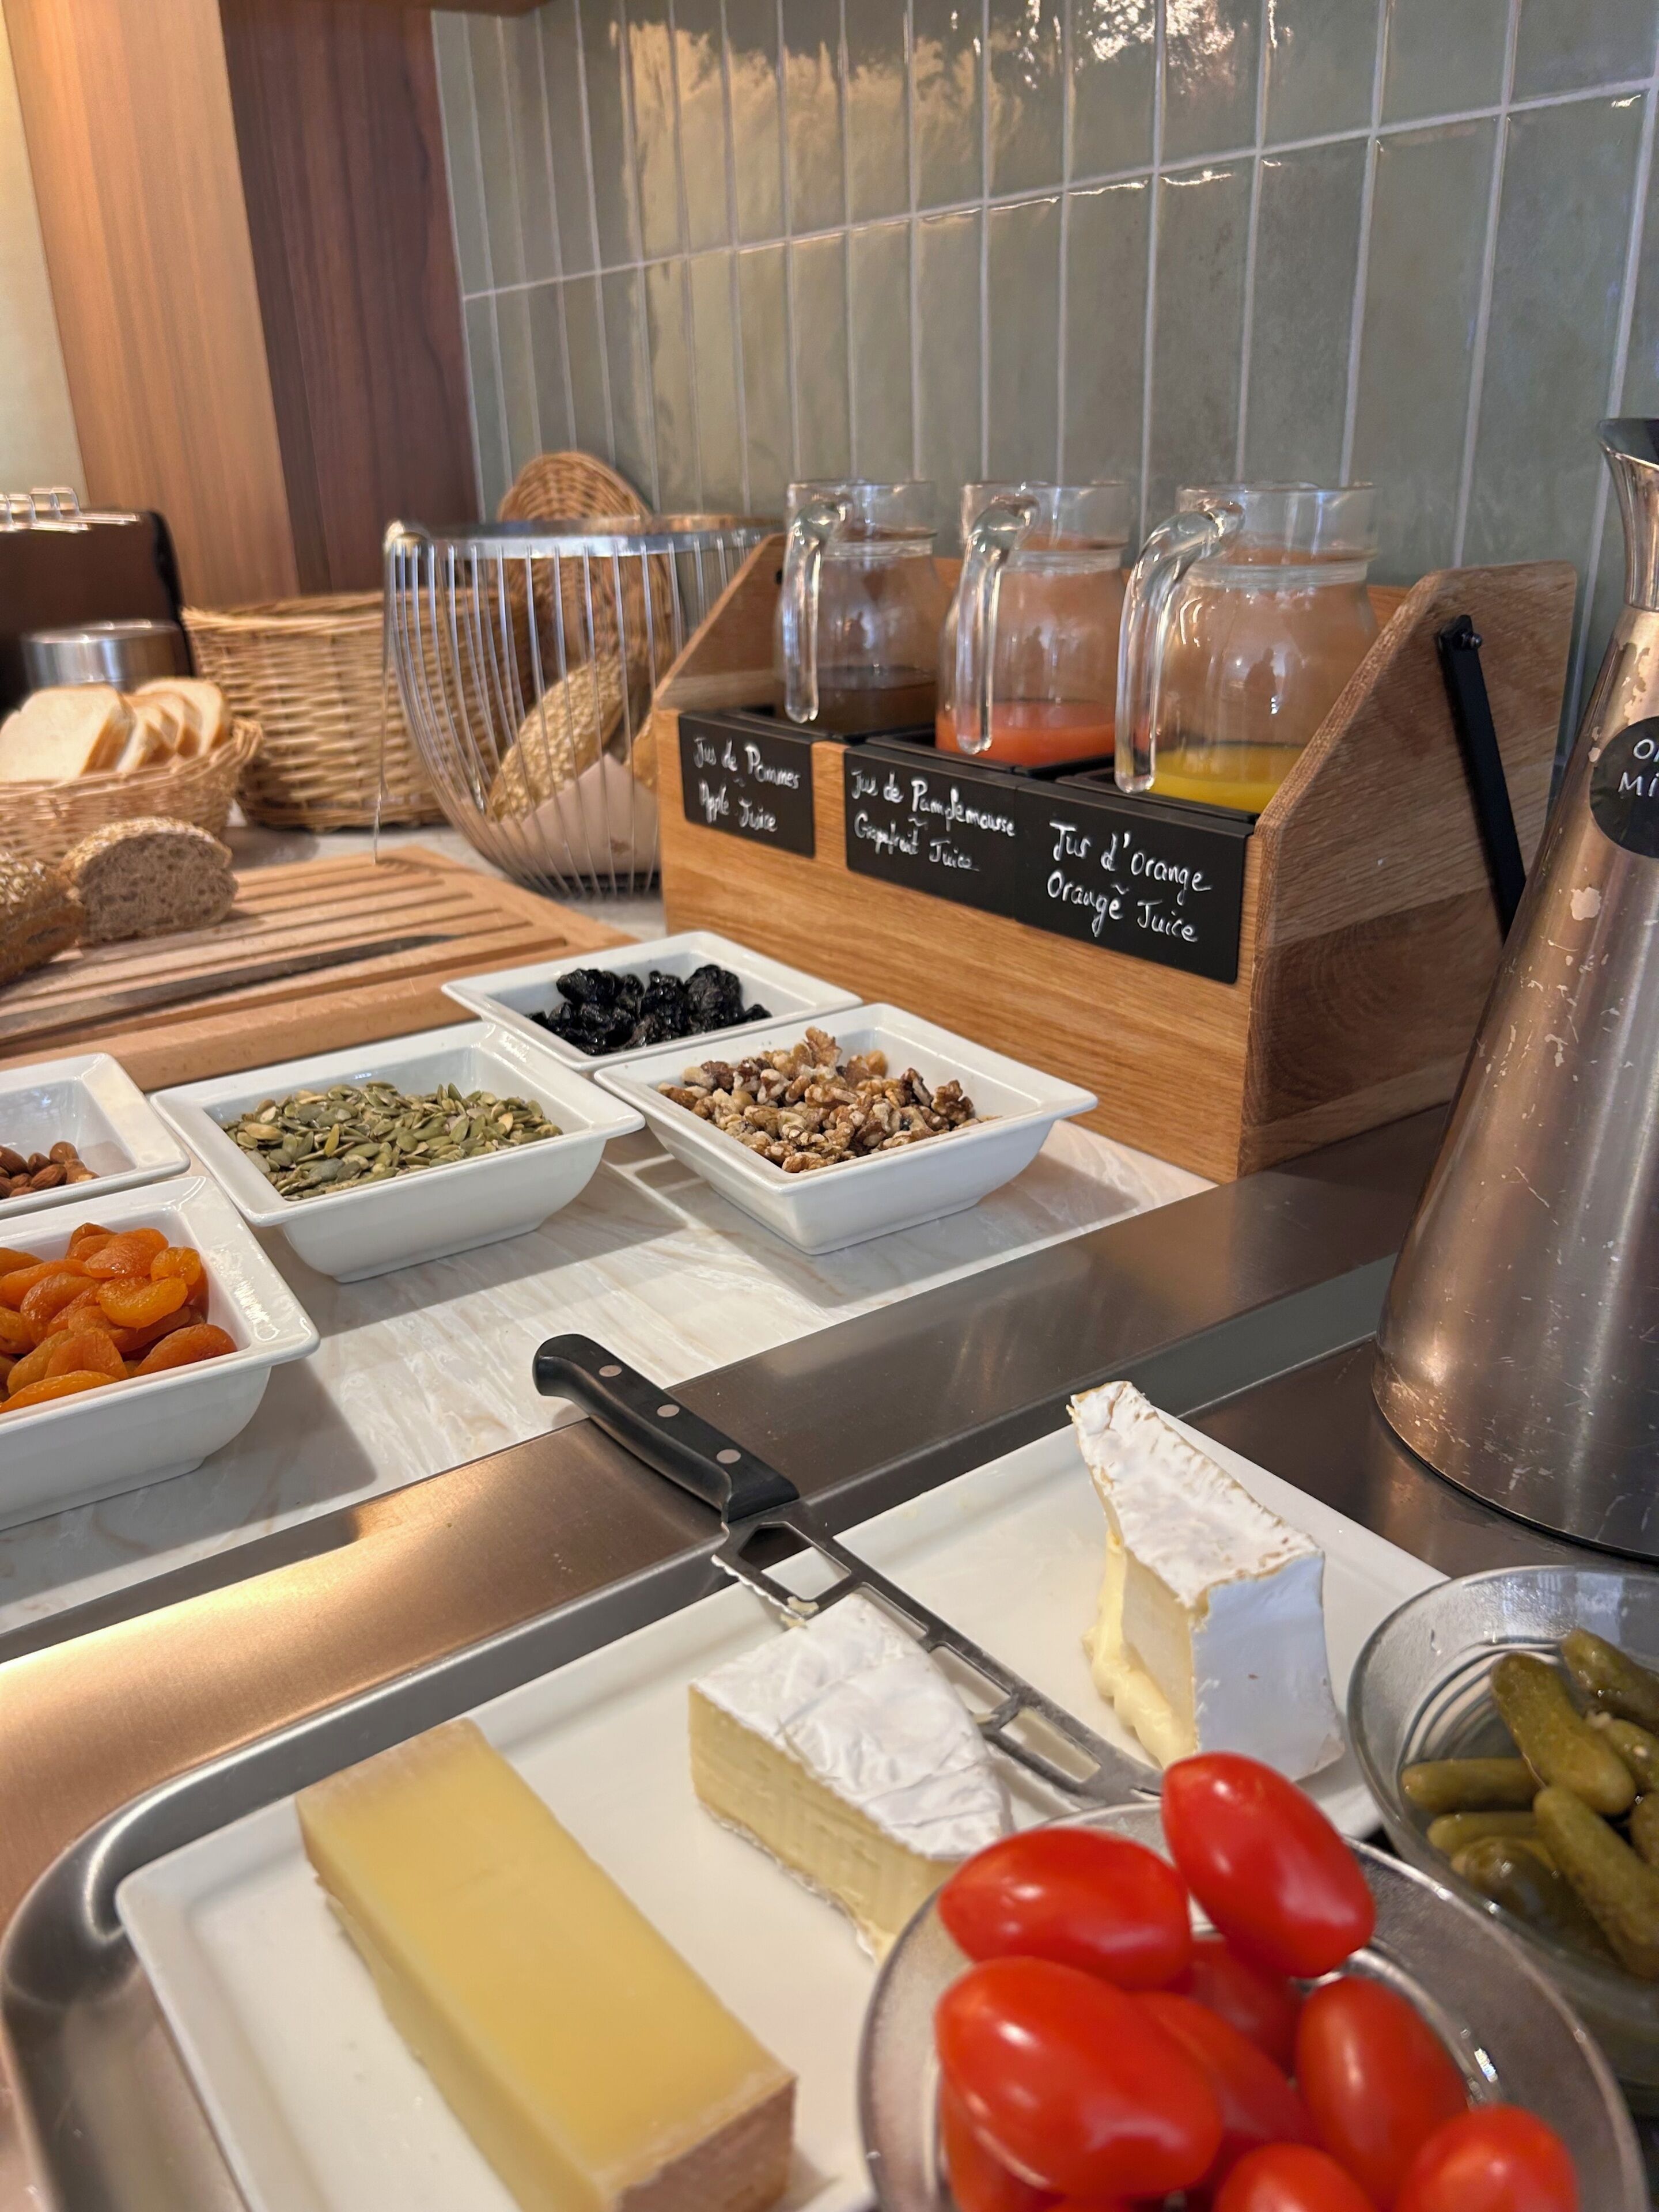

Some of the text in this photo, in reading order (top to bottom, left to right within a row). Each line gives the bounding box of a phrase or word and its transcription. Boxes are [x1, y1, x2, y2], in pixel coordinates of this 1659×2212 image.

[693, 736, 801, 790] Jus de Pommes
[1633, 738, 1659, 763] O
[737, 797, 778, 833] Juice
[851, 768, 1016, 838] Jus de Pamplemousse
[928, 838, 980, 872] Juice
[1049, 820, 1092, 862] Jus
[1047, 868, 1199, 943] Orange Juice
